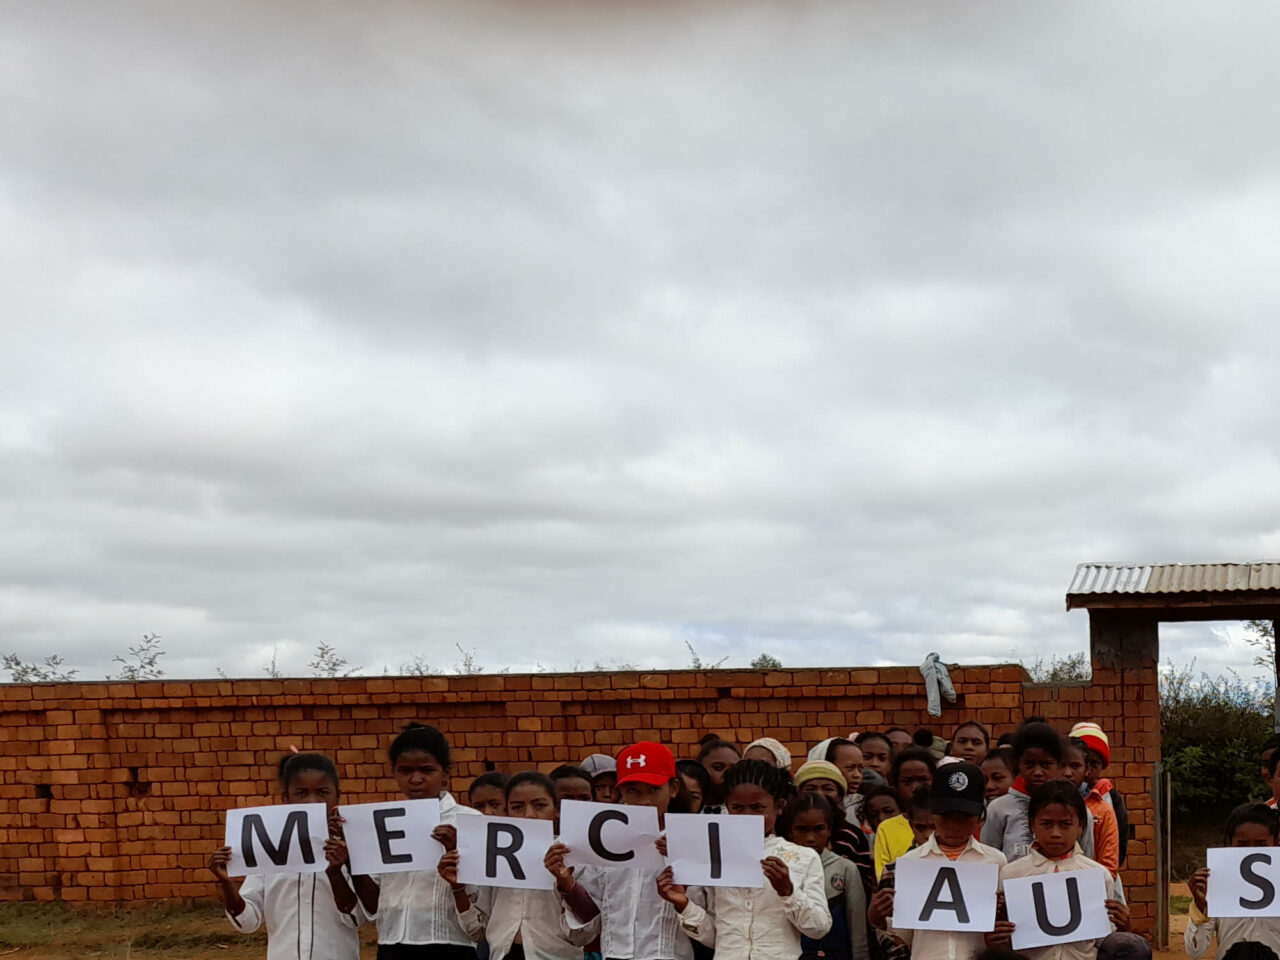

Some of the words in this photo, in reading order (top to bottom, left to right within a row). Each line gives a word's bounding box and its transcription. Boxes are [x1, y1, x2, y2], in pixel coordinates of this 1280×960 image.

[240, 810, 316, 868] M
[372, 807, 414, 865] E
[485, 821, 527, 881] R
[587, 809, 636, 863] C
[918, 866, 971, 924] A
[1031, 876, 1082, 937] U
[1238, 852, 1276, 910] S
